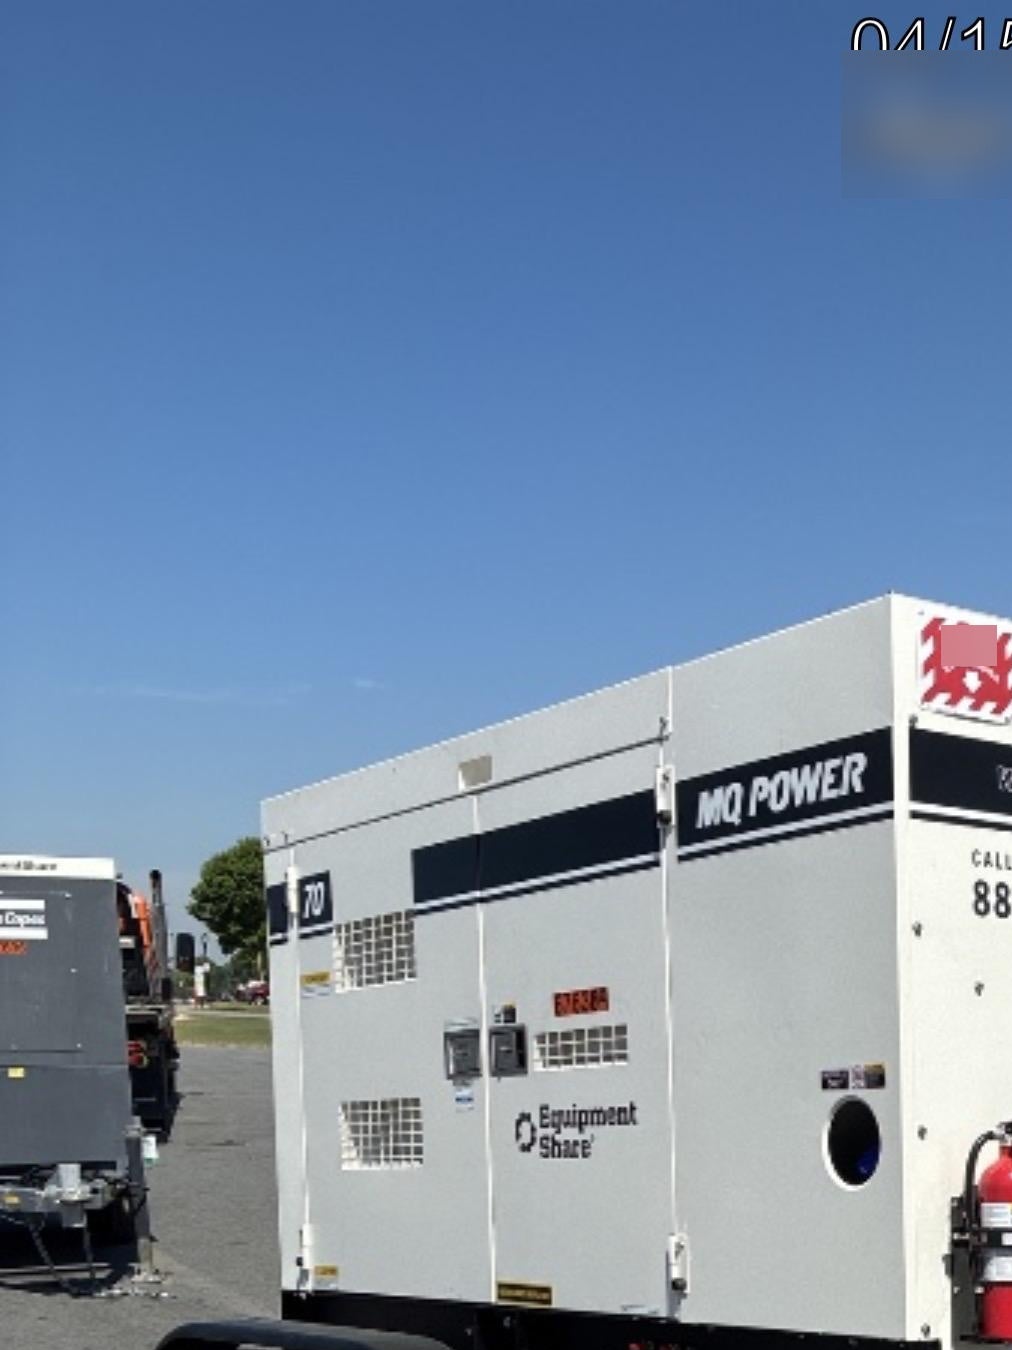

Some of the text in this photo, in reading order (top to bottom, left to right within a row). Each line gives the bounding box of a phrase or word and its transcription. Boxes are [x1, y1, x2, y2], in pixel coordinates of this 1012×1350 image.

[695, 752, 868, 829] MQ POWER
[302, 881, 325, 919] 70
[539, 1101, 637, 1134] Equipment
[539, 1134, 592, 1159] Share
